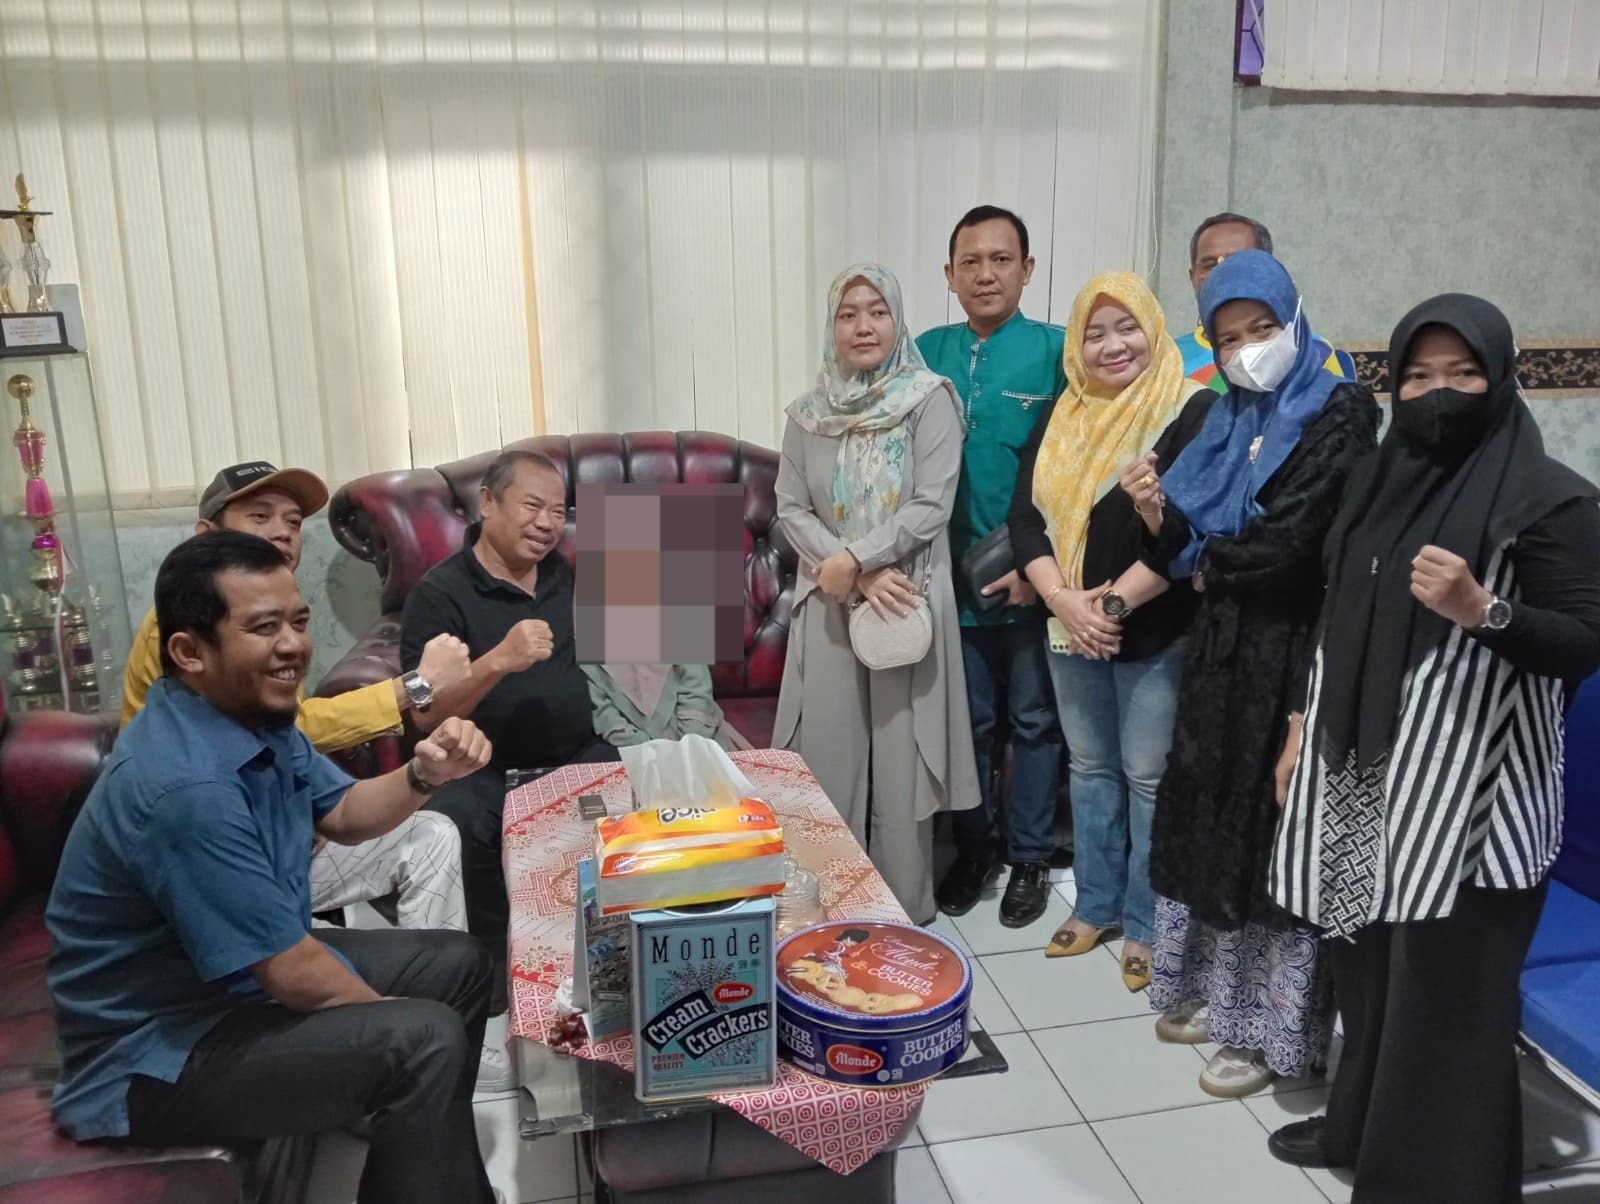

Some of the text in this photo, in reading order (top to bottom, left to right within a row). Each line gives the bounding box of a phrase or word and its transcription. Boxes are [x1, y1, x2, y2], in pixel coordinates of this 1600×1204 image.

[651, 928, 760, 963] Monde
[718, 986, 750, 998] Monde
[867, 968, 932, 996] COOKIES
[880, 964, 933, 988] BUTTER
[647, 998, 709, 1044] Cream
[685, 1010, 768, 1055] Crackers
[903, 1018, 961, 1053] BUTTER
[834, 1052, 876, 1067] Monde
[900, 1030, 962, 1067] COOKIES
